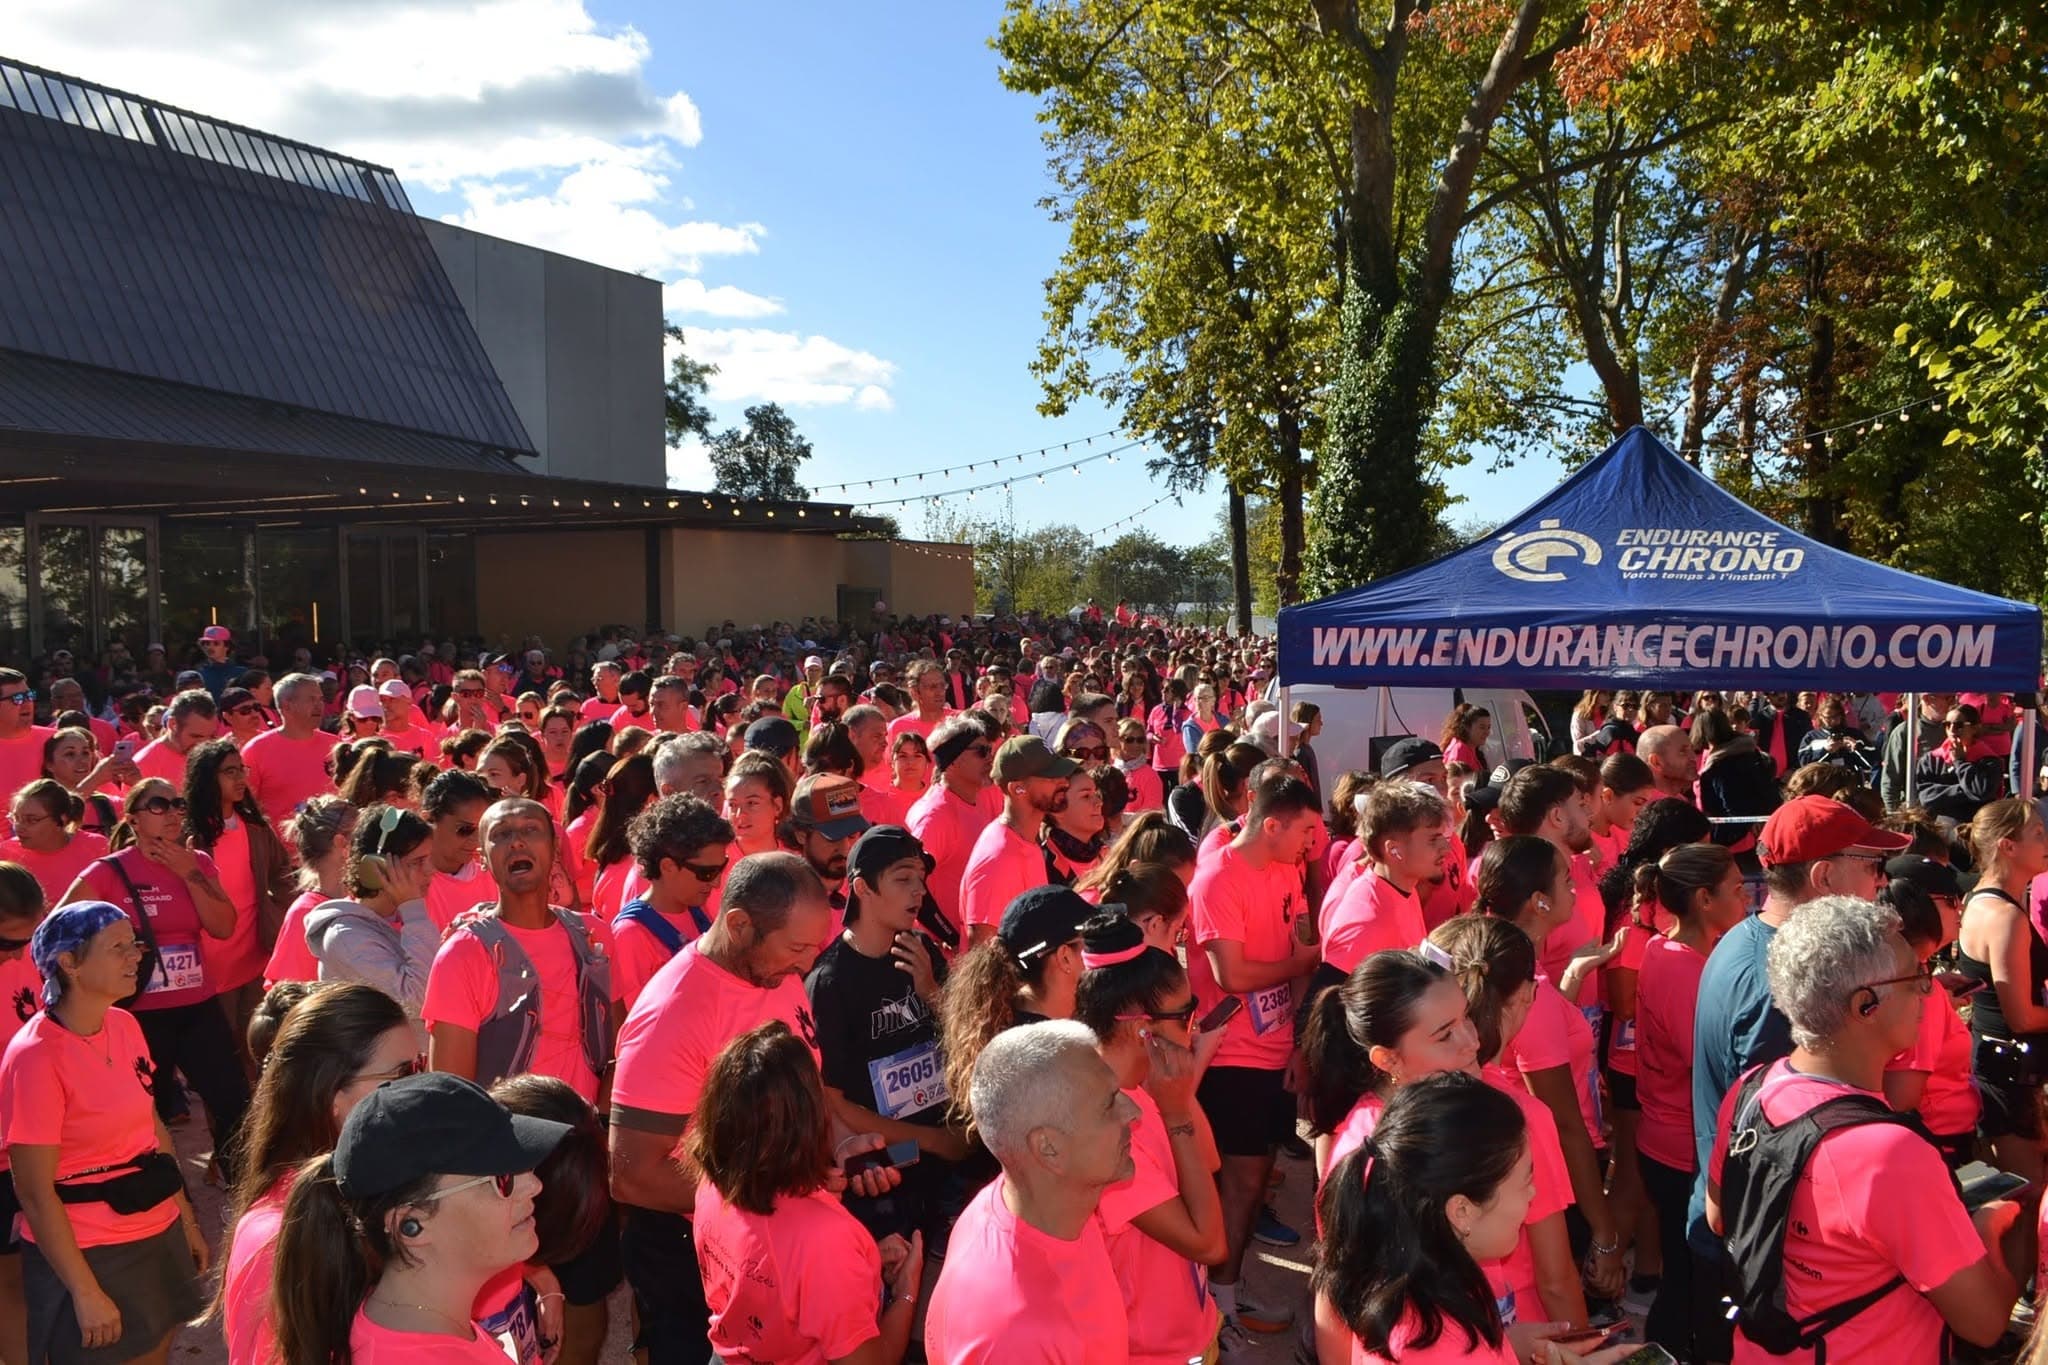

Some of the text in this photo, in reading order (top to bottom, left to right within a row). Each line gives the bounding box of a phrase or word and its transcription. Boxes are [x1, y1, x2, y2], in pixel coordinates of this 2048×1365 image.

[1616, 528, 1780, 547] ENDURANCE
[1617, 547, 1805, 572] CHRONO
[1622, 571, 1789, 582] Votre temps à l'instant T
[1312, 624, 1996, 668] WWW.ENDURANCECHRONO.COM
[1259, 986, 1289, 1013] 2382
[886, 1056, 933, 1094] 2605
